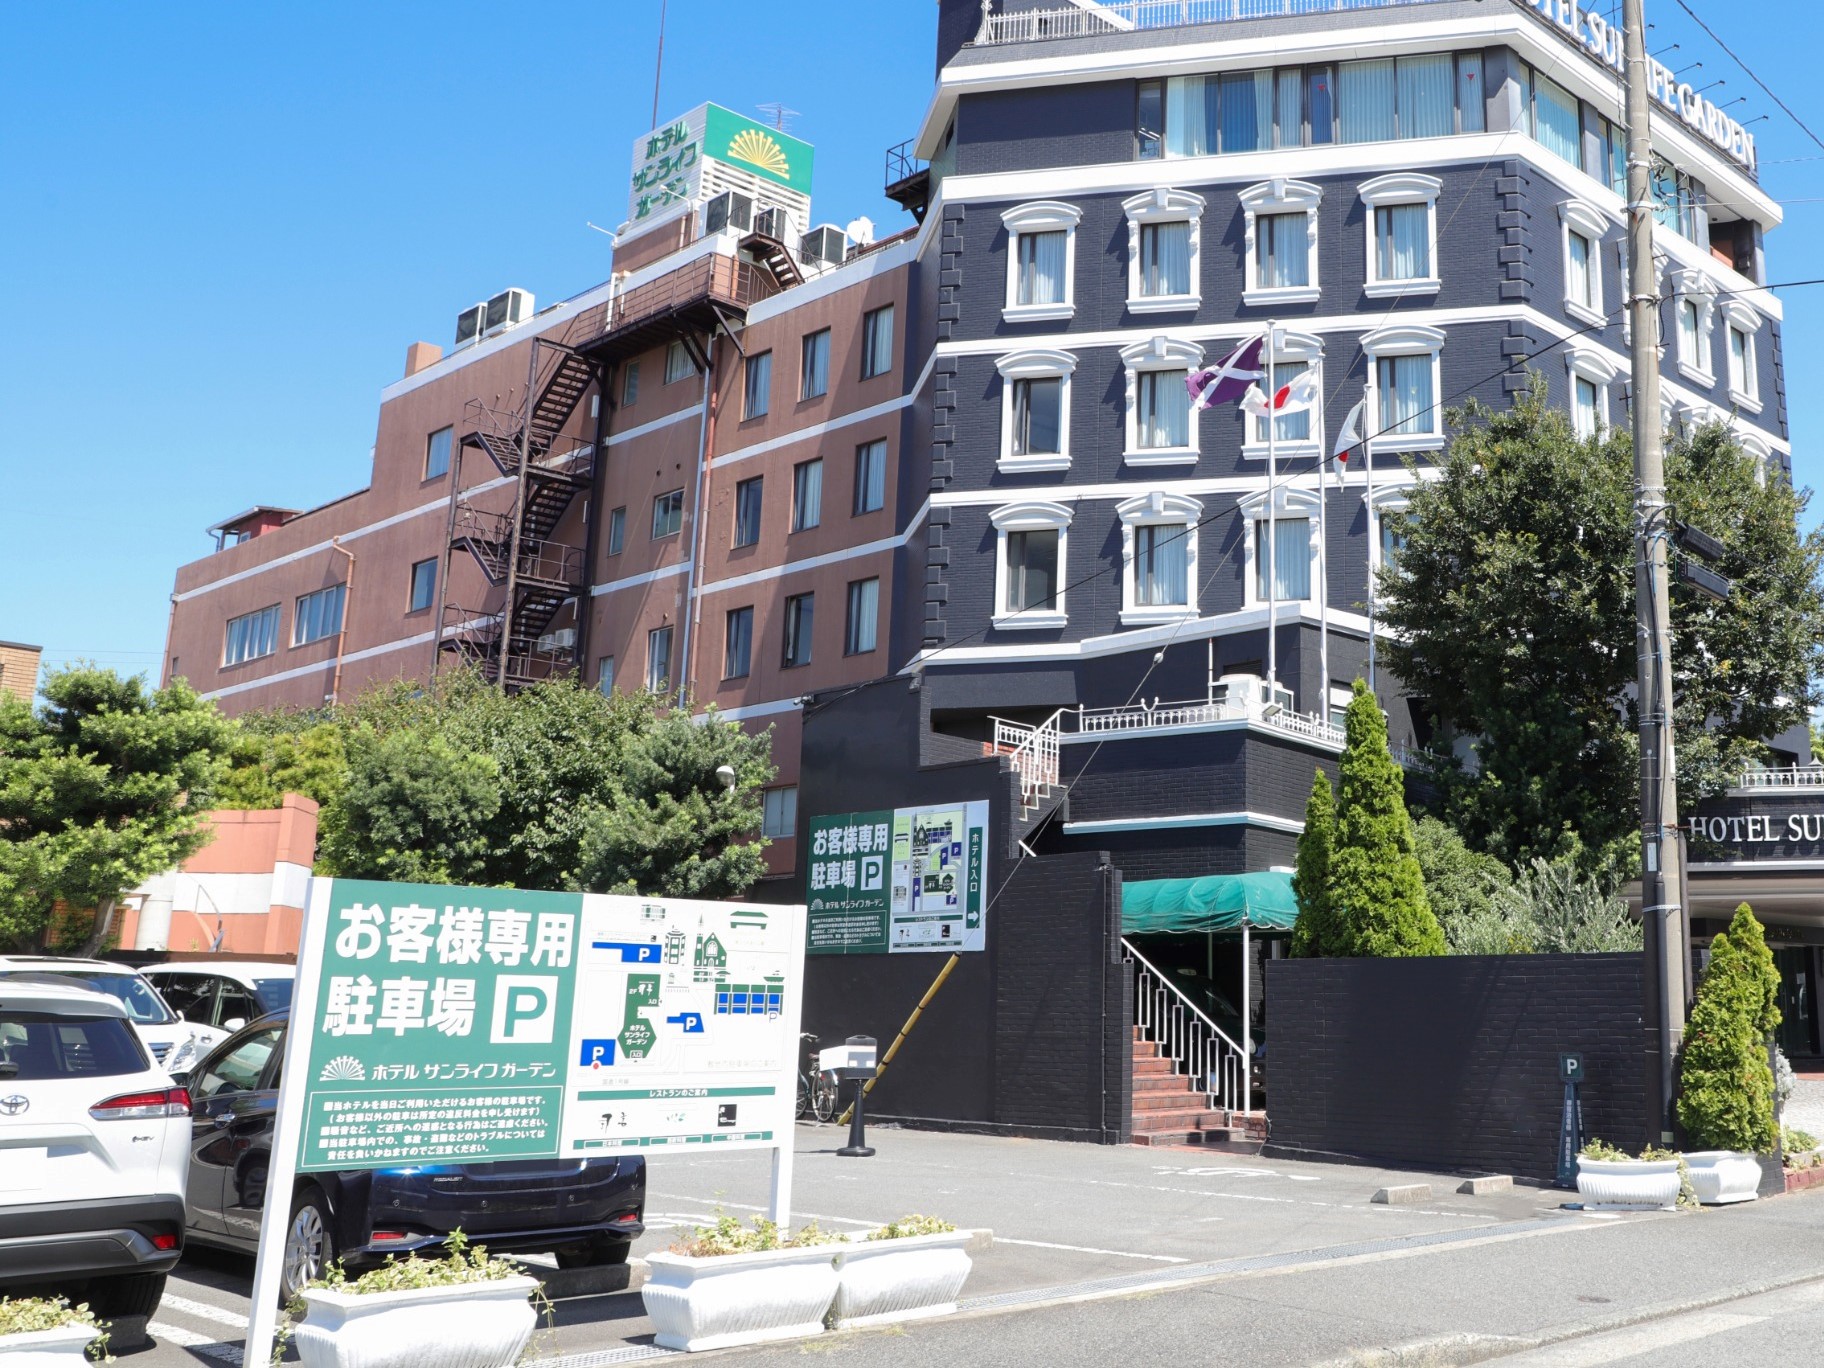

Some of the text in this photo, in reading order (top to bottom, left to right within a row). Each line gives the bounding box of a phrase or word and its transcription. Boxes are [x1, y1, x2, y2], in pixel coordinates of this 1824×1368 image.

[646, 121, 688, 159] ホテル
[1677, 83, 1755, 172] GARDEN
[633, 141, 699, 193] サンライフ
[635, 176, 688, 219] ガーデン
[813, 823, 889, 855] お客様専用
[1688, 814, 1824, 842] HOTEL SU
[810, 860, 856, 890] 駐車場
[865, 862, 879, 888] P
[970, 833, 980, 892] ホテル入口
[825, 899, 884, 909] ホテル サンライフ ガーデン
[335, 903, 576, 968] お客様専用
[638, 948, 650, 962] P
[321, 974, 476, 1037] 駐車場
[503, 986, 548, 1037] P
[686, 1017, 697, 1030] P
[593, 1046, 604, 1060] P
[1567, 1059, 1578, 1074] P
[371, 1062, 556, 1081] ホテル サンライフ ガーデン
[649, 1089, 708, 1098] レストランのご案内
